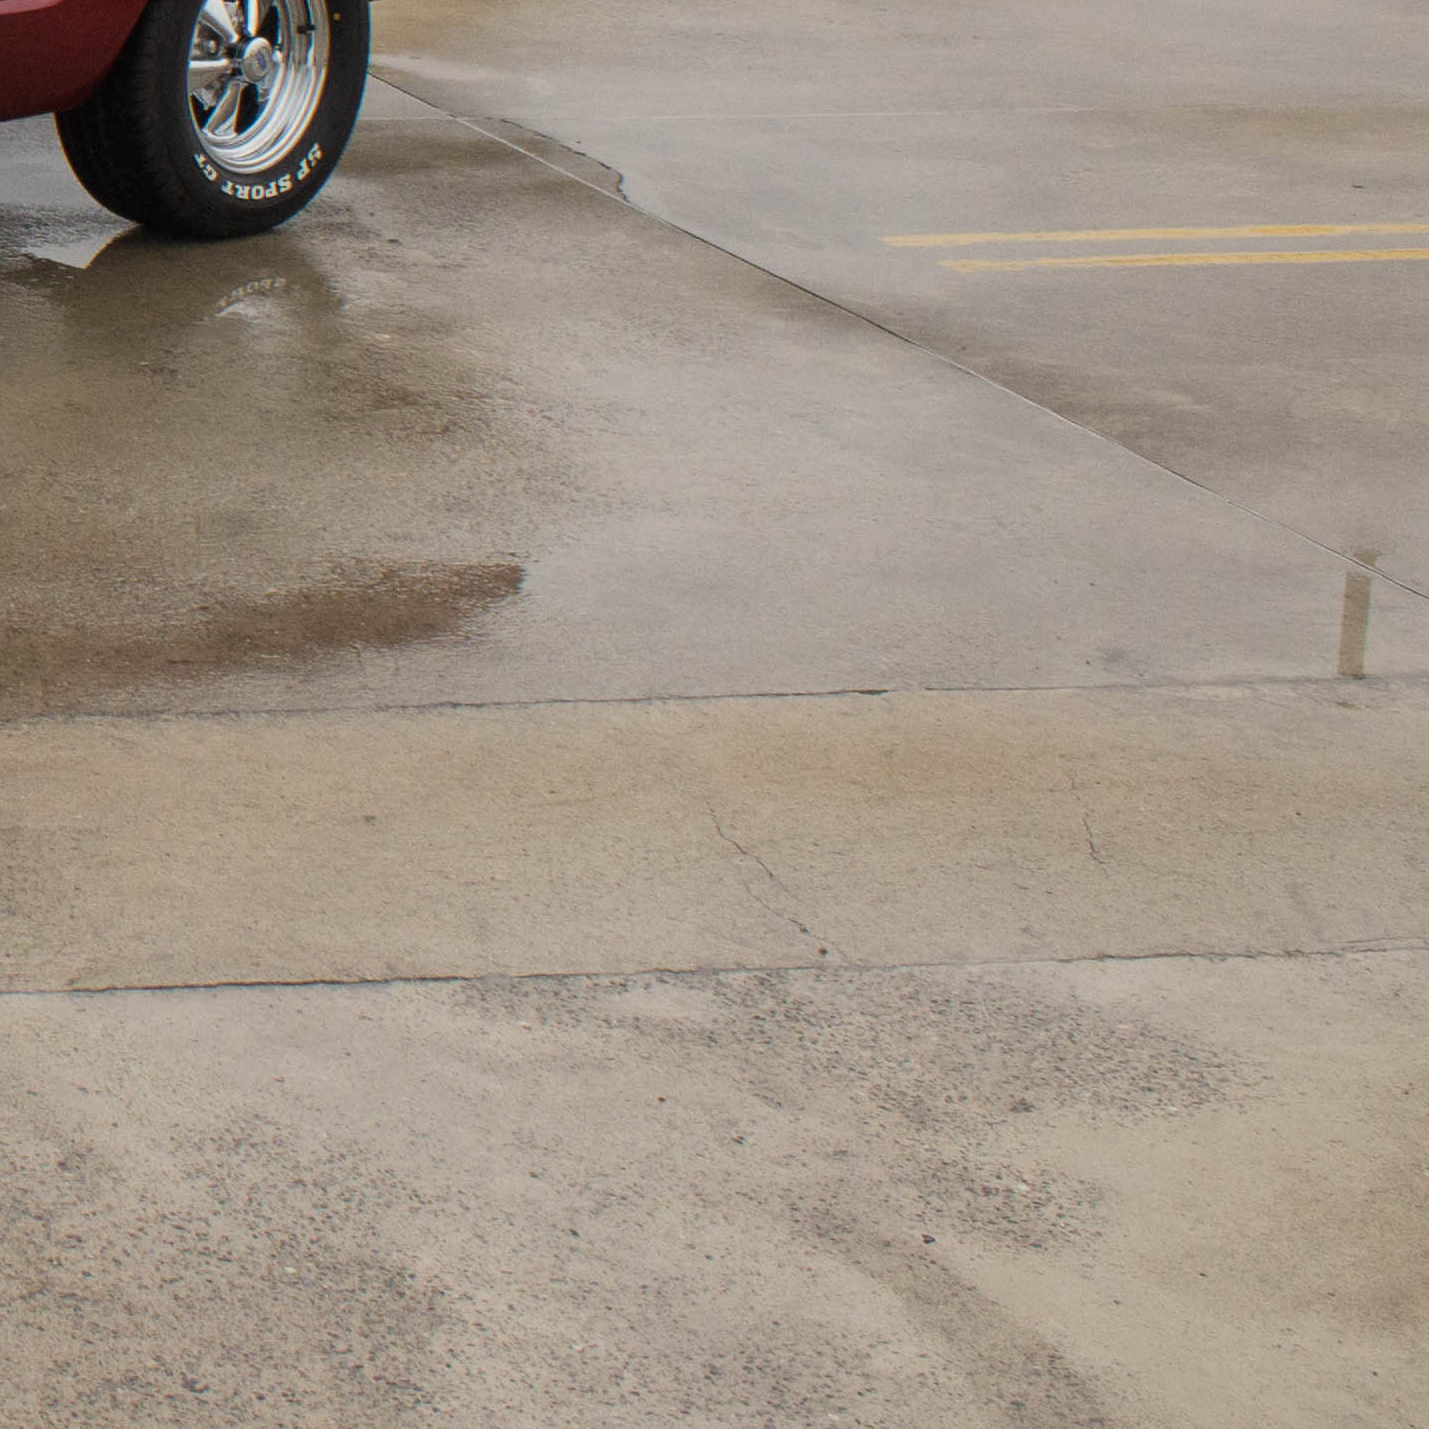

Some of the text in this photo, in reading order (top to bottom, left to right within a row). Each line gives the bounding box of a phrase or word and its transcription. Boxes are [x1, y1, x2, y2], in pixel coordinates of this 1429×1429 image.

[192, 141, 324, 200] SP SPORT GT
